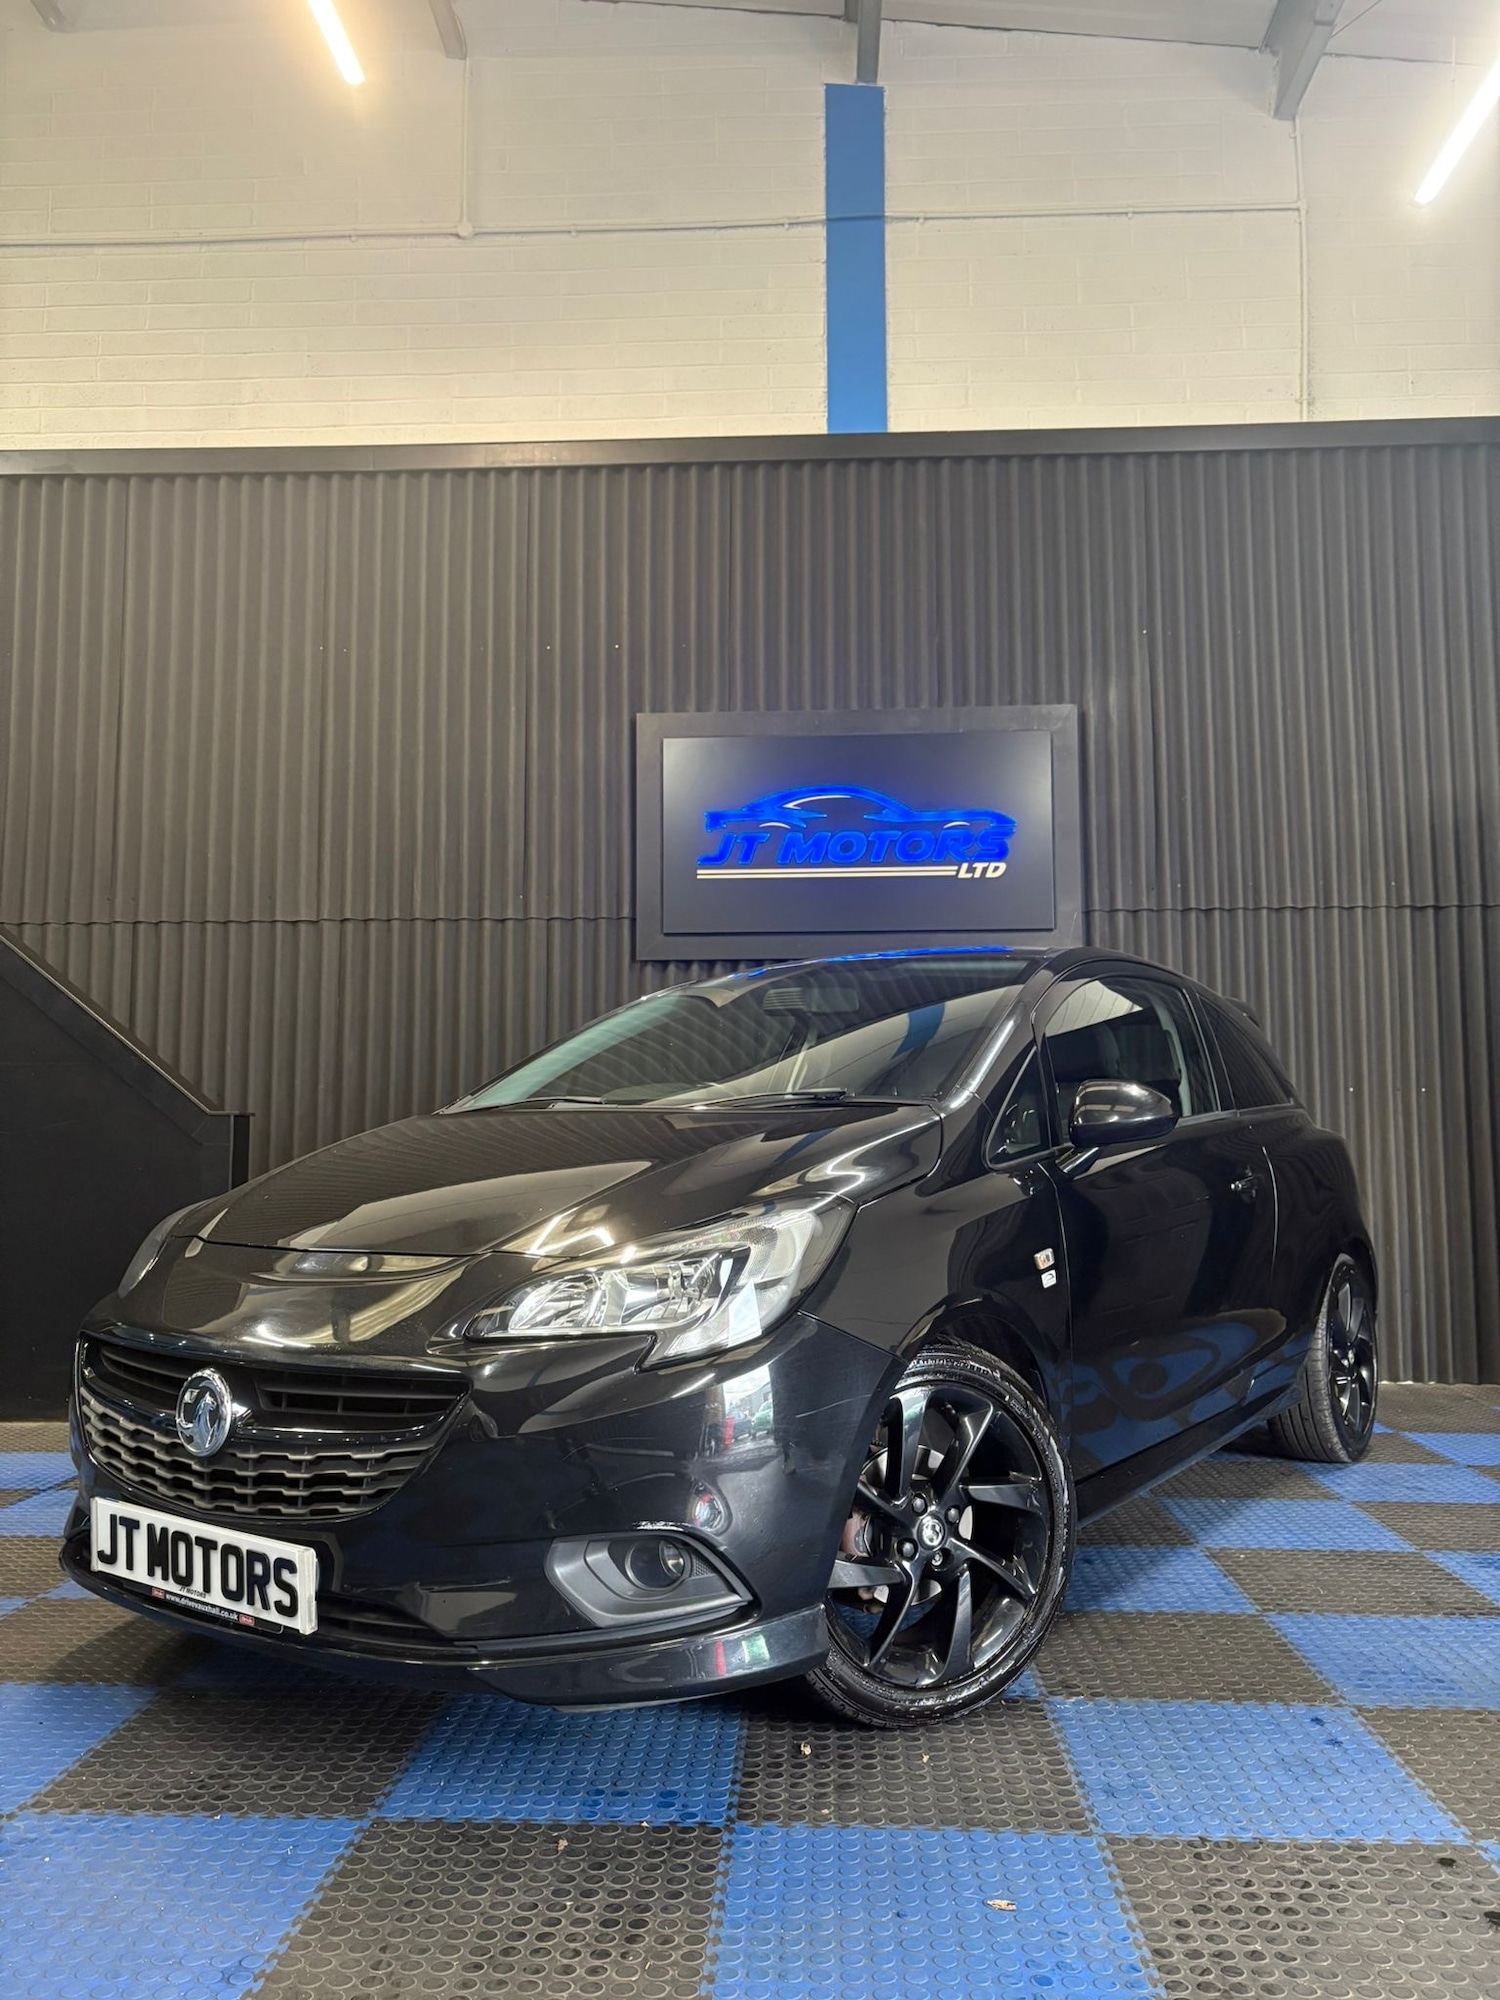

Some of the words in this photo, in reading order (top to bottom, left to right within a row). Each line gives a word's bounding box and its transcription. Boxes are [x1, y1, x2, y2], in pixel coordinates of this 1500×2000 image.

[697, 833, 770, 865] JT
[777, 830, 1016, 864] MOTORS
[957, 862, 1006, 878] LTD
[97, 1514, 140, 1570] JT
[147, 1523, 298, 1617] MOTORS
[186, 1587, 207, 1599] MOTORS
[166, 1594, 238, 1620] www.drivevauxhall.co.uk
